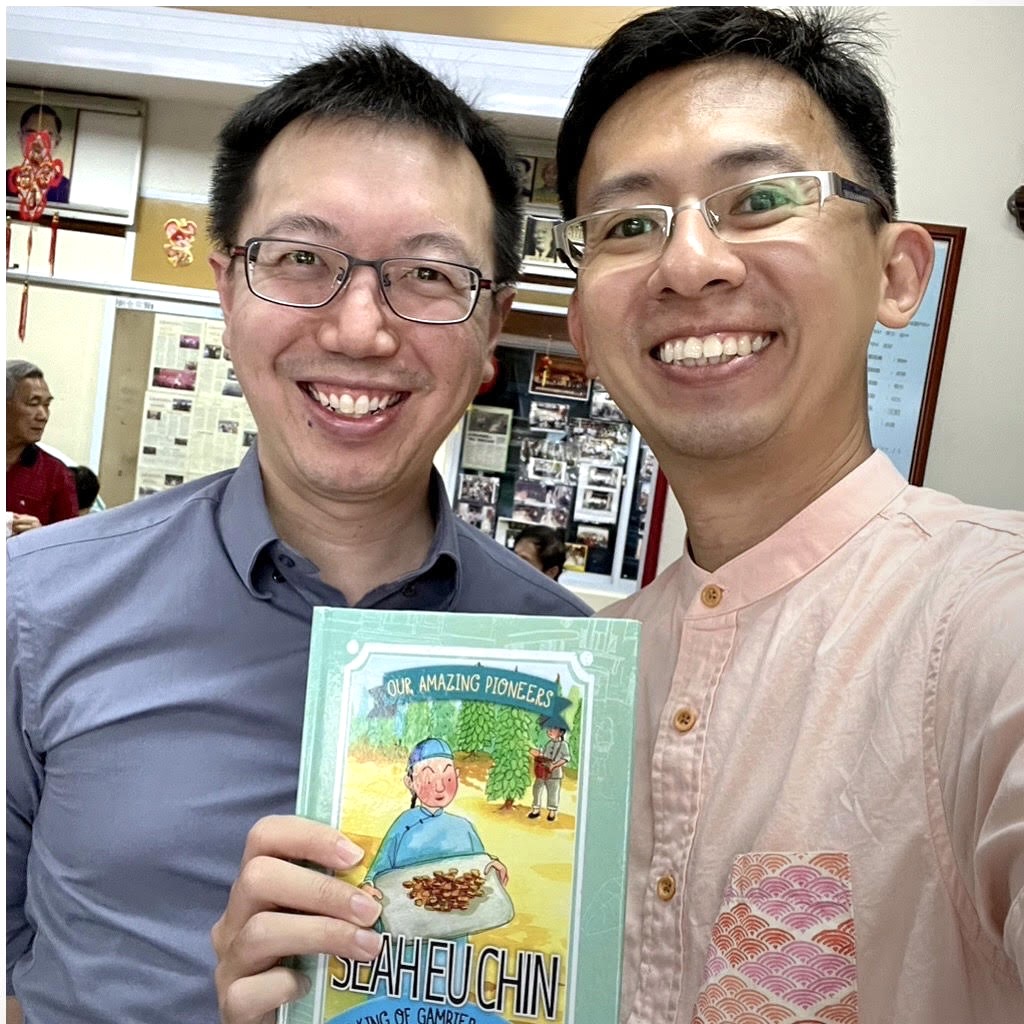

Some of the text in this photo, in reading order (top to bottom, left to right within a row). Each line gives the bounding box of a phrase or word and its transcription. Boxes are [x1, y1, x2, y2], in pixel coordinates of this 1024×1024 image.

[386, 673, 555, 709] OUR AMAZING PIONEERS
[331, 932, 561, 1019] SEAH EU CHIN
